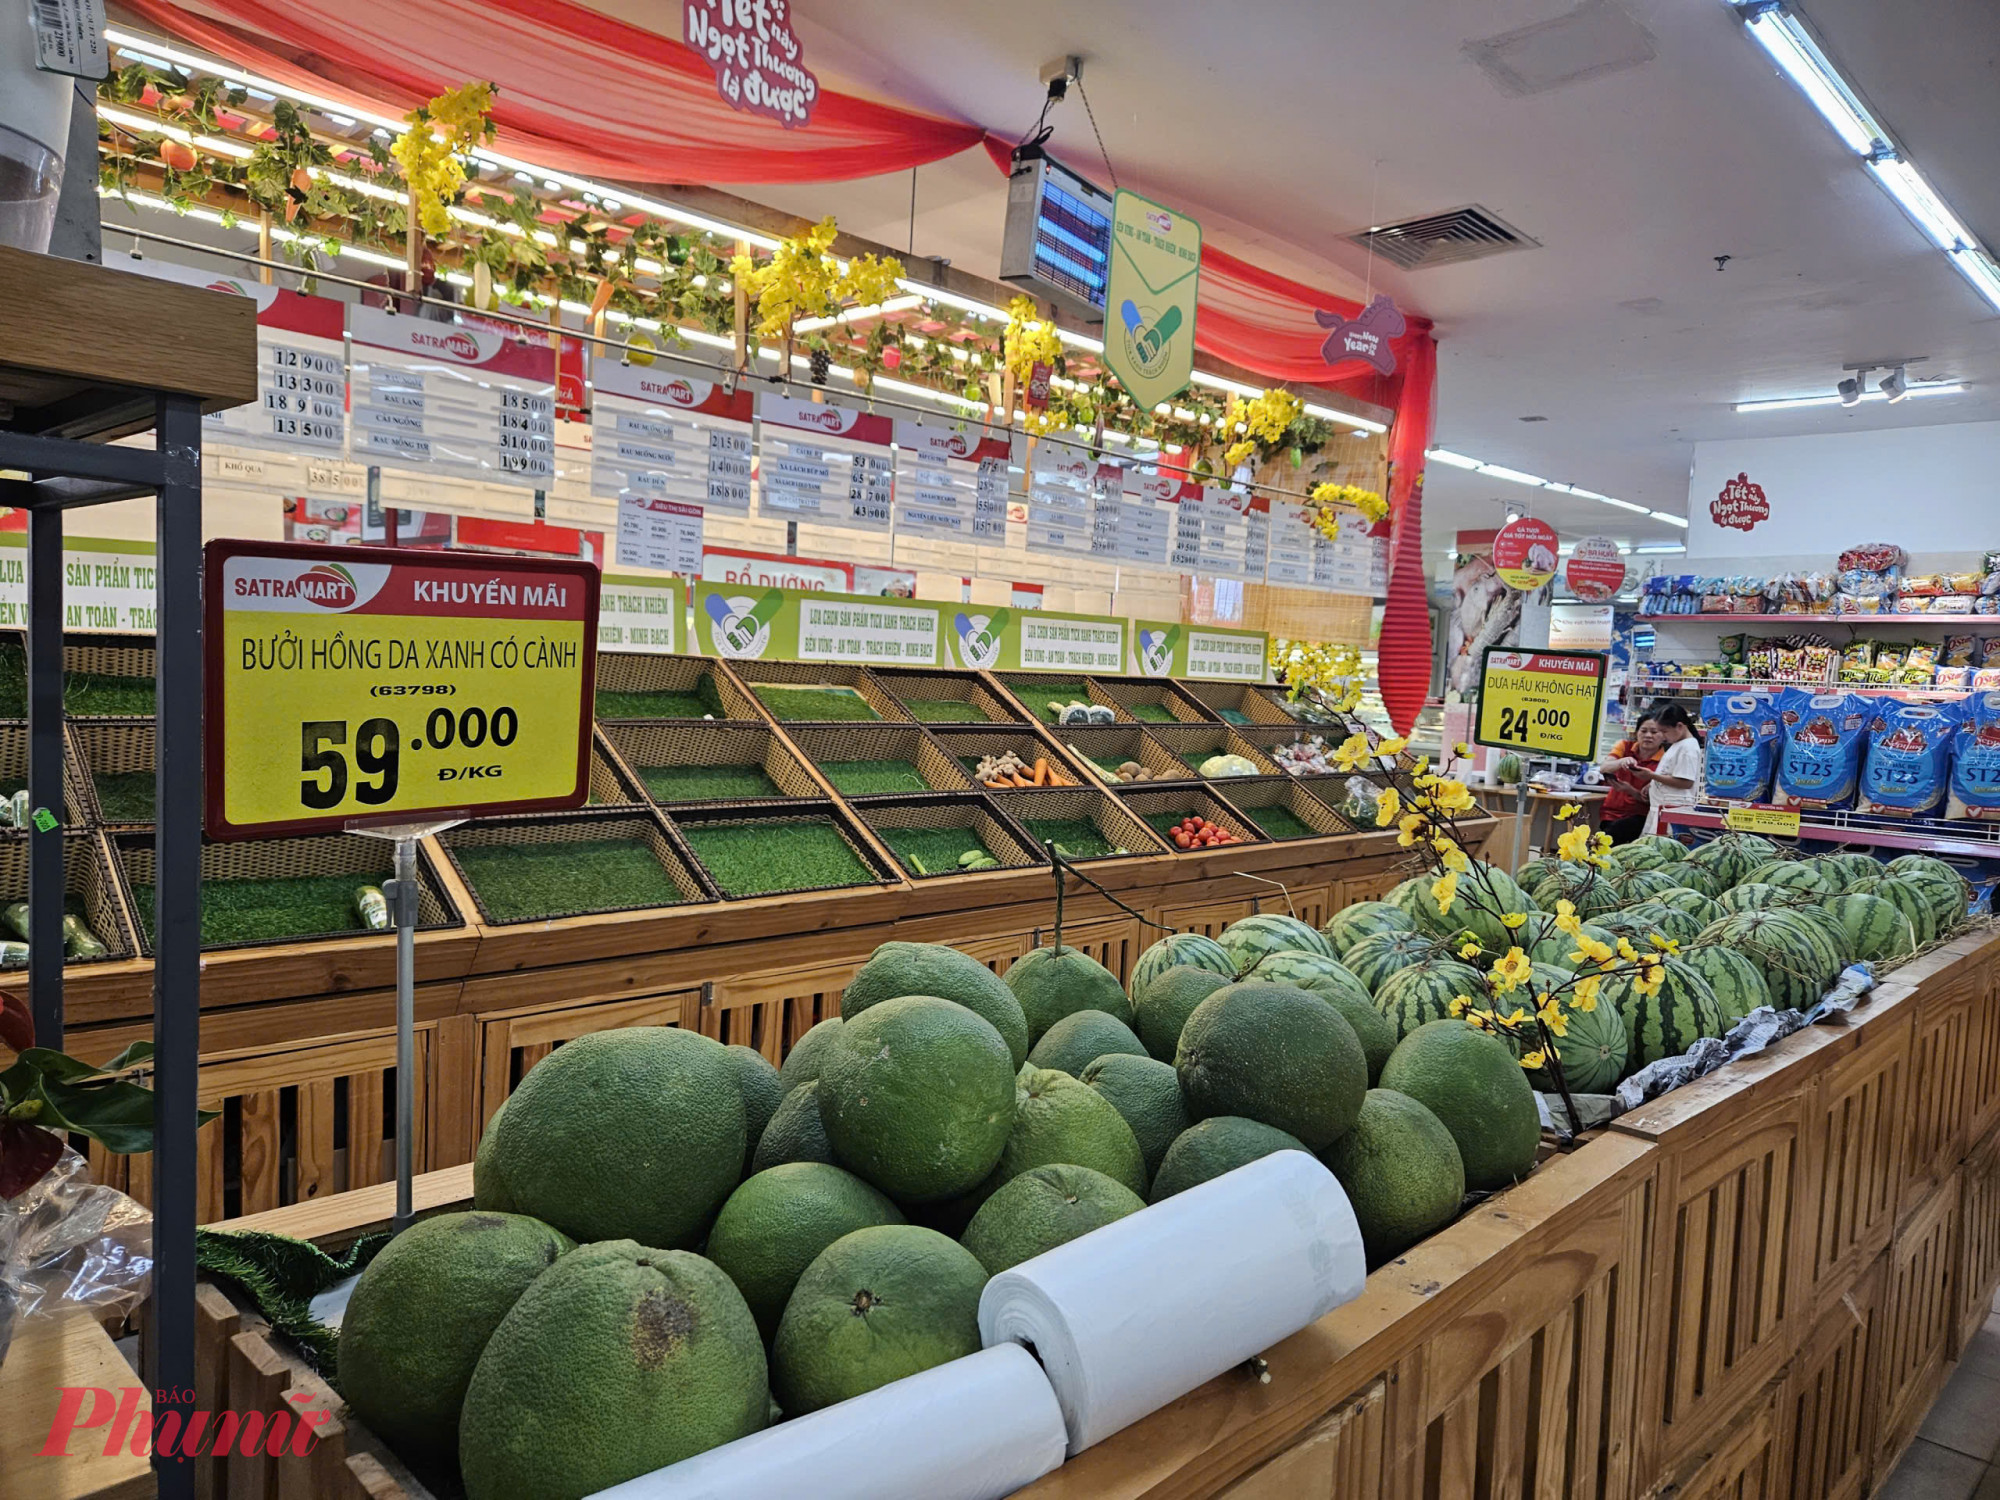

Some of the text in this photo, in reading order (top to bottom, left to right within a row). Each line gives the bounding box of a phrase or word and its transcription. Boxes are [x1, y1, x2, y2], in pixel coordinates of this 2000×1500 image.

[770, 22, 798, 61] này
[688, 4, 815, 102] Ngọt Thương
[722, 67, 807, 122] là được
[1344, 338, 1369, 352] Year
[225, 460, 262, 475] KHỔ QUA
[1728, 482, 1748, 500] Tết
[1713, 500, 1739, 516] Ngọt
[66, 557, 91, 588] SẢN
[95, 557, 130, 589] PHẨM
[133, 566, 156, 590] TIC
[234, 576, 349, 601] SATRAMART
[413, 577, 567, 608] KHUYẾN MÃI
[617, 591, 642, 613] TRÁCH
[66, 601, 118, 628] AN TOÀN
[630, 627, 649, 645] MINH
[242, 628, 576, 670] BƯỞI HỒNG DA XANH CÓ CÀNH
[1538, 657, 1594, 672] KHUYẾN MÃI
[370, 684, 457, 698] (63798)
[1487, 676, 1598, 700] DƯA HẤU KHÔNG HẠT
[437, 765, 503, 782] Đ/KG
[1709, 763, 1747, 778] ST25
[1788, 761, 1833, 778] ST25
[1872, 767, 1920, 785] ST25
[1965, 768, 2000, 783] ST2
